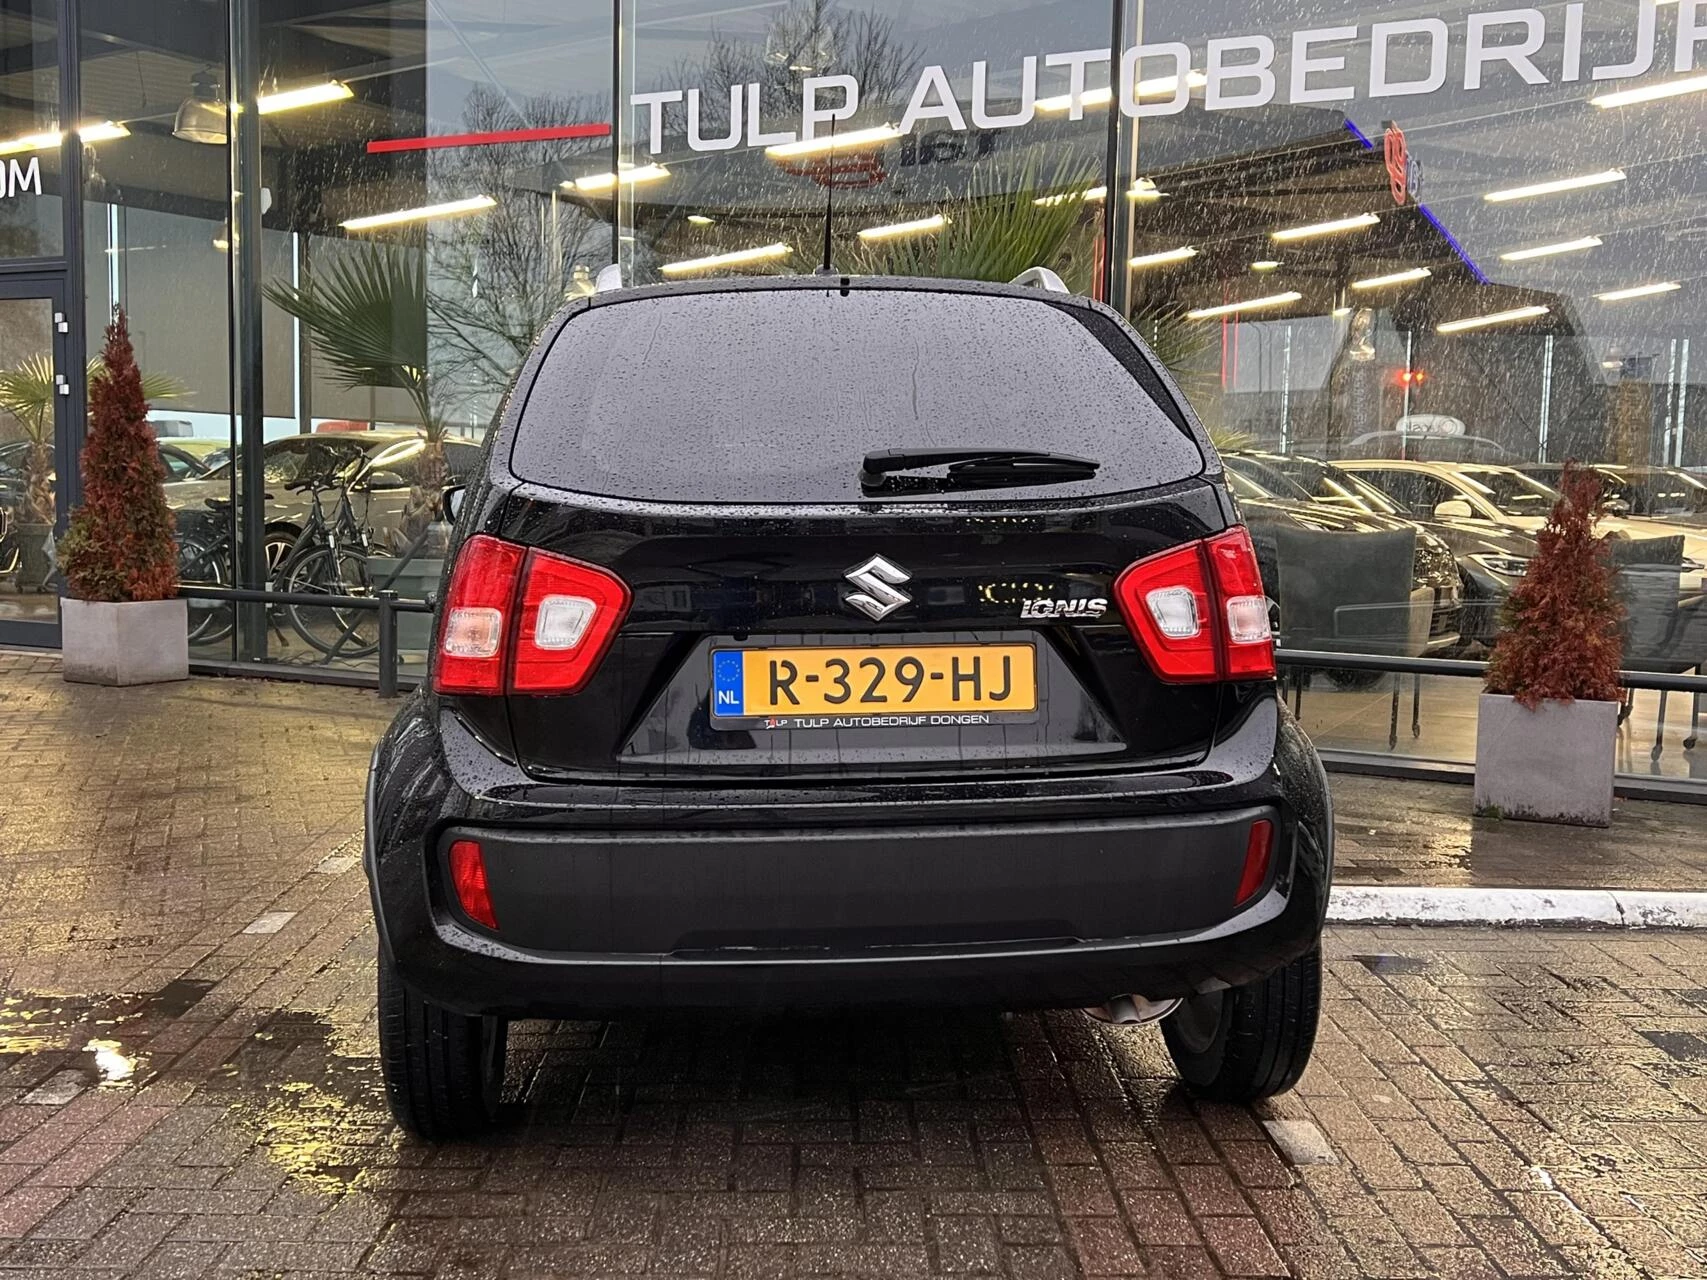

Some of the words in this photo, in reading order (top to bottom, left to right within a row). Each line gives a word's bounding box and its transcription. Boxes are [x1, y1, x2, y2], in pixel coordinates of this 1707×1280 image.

[630, 74, 859, 154] TULP
[1020, 598, 1108, 619] IGNIS
[769, 655, 1011, 706] R-329-HJ
[718, 690, 739, 705] NL
[794, 717, 829, 728] TULP
[833, 715, 927, 727] AUTOBEDRIJF
[931, 714, 990, 726] DONGEN
